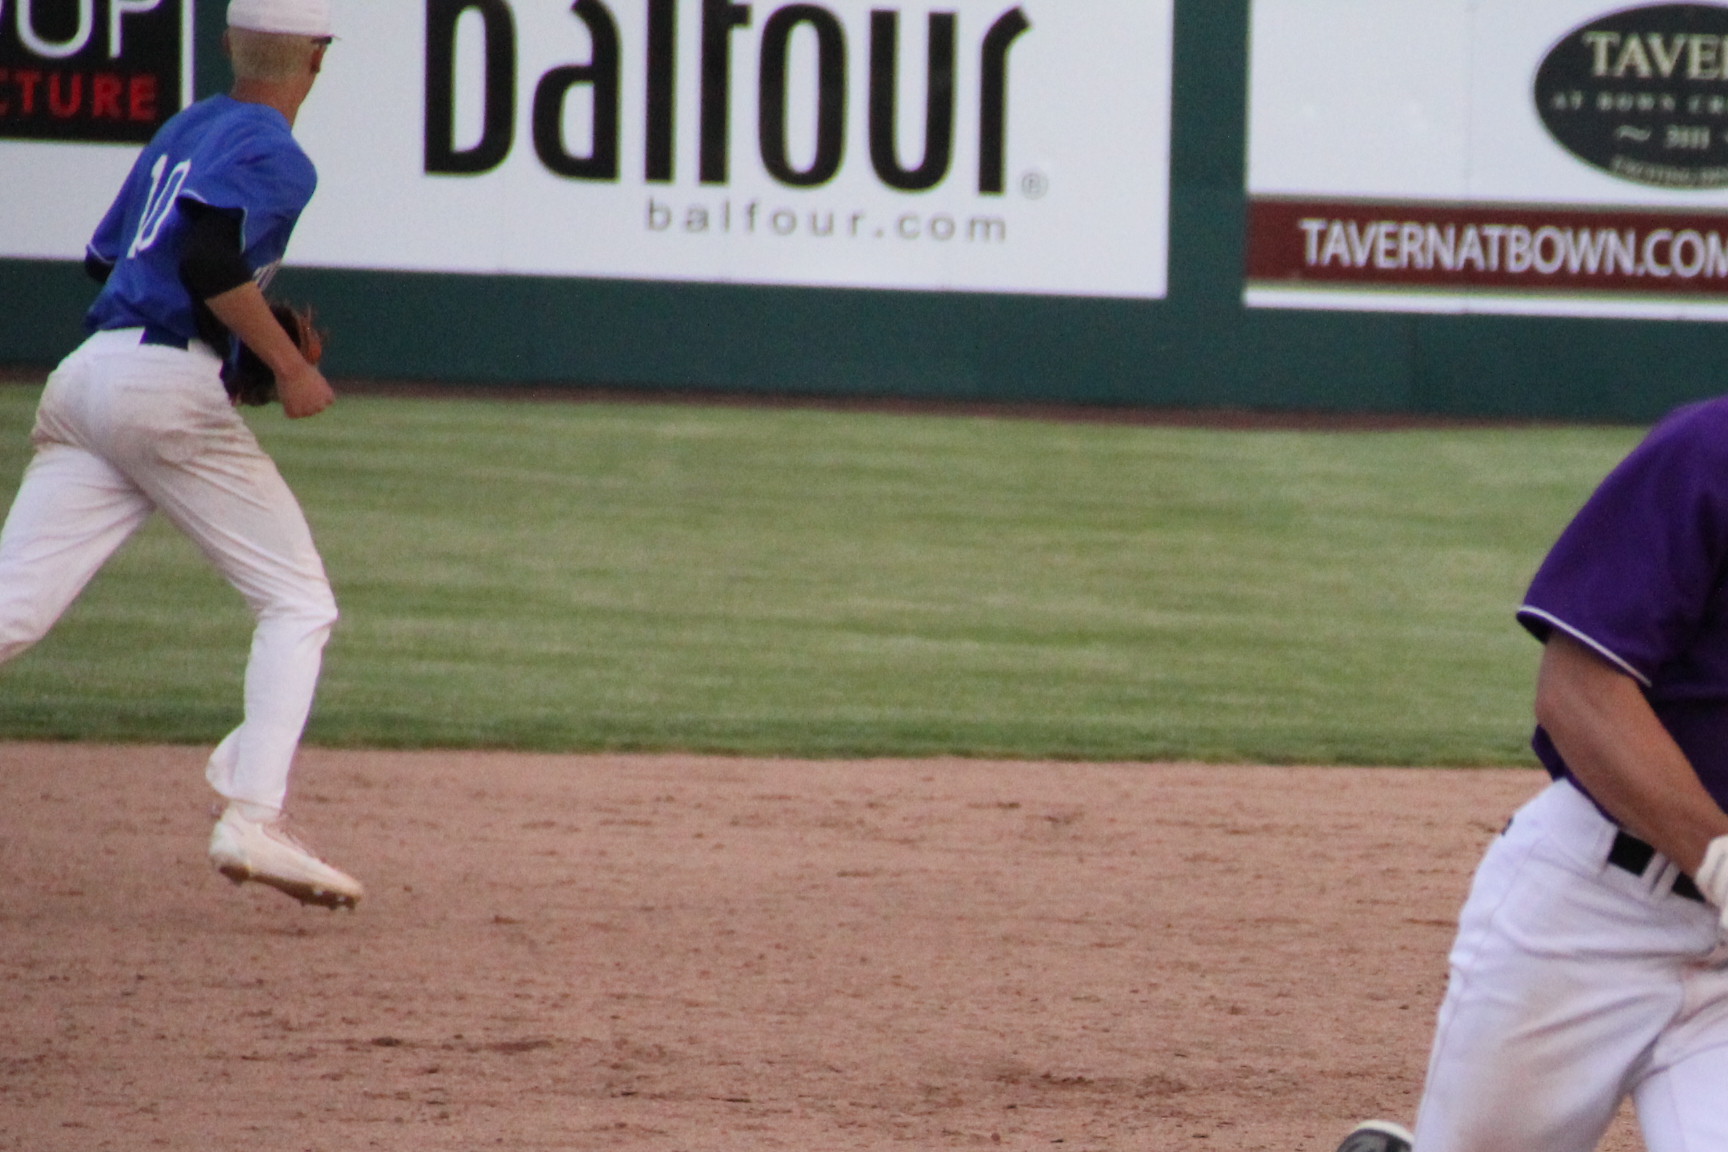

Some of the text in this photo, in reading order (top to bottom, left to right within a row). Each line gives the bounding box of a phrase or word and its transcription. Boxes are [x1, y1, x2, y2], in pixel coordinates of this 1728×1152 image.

[0, 68, 158, 121] TURE
[424, 0, 1031, 196] balfour
[126, 153, 192, 259] 10
[646, 198, 1006, 242] balfour.com
